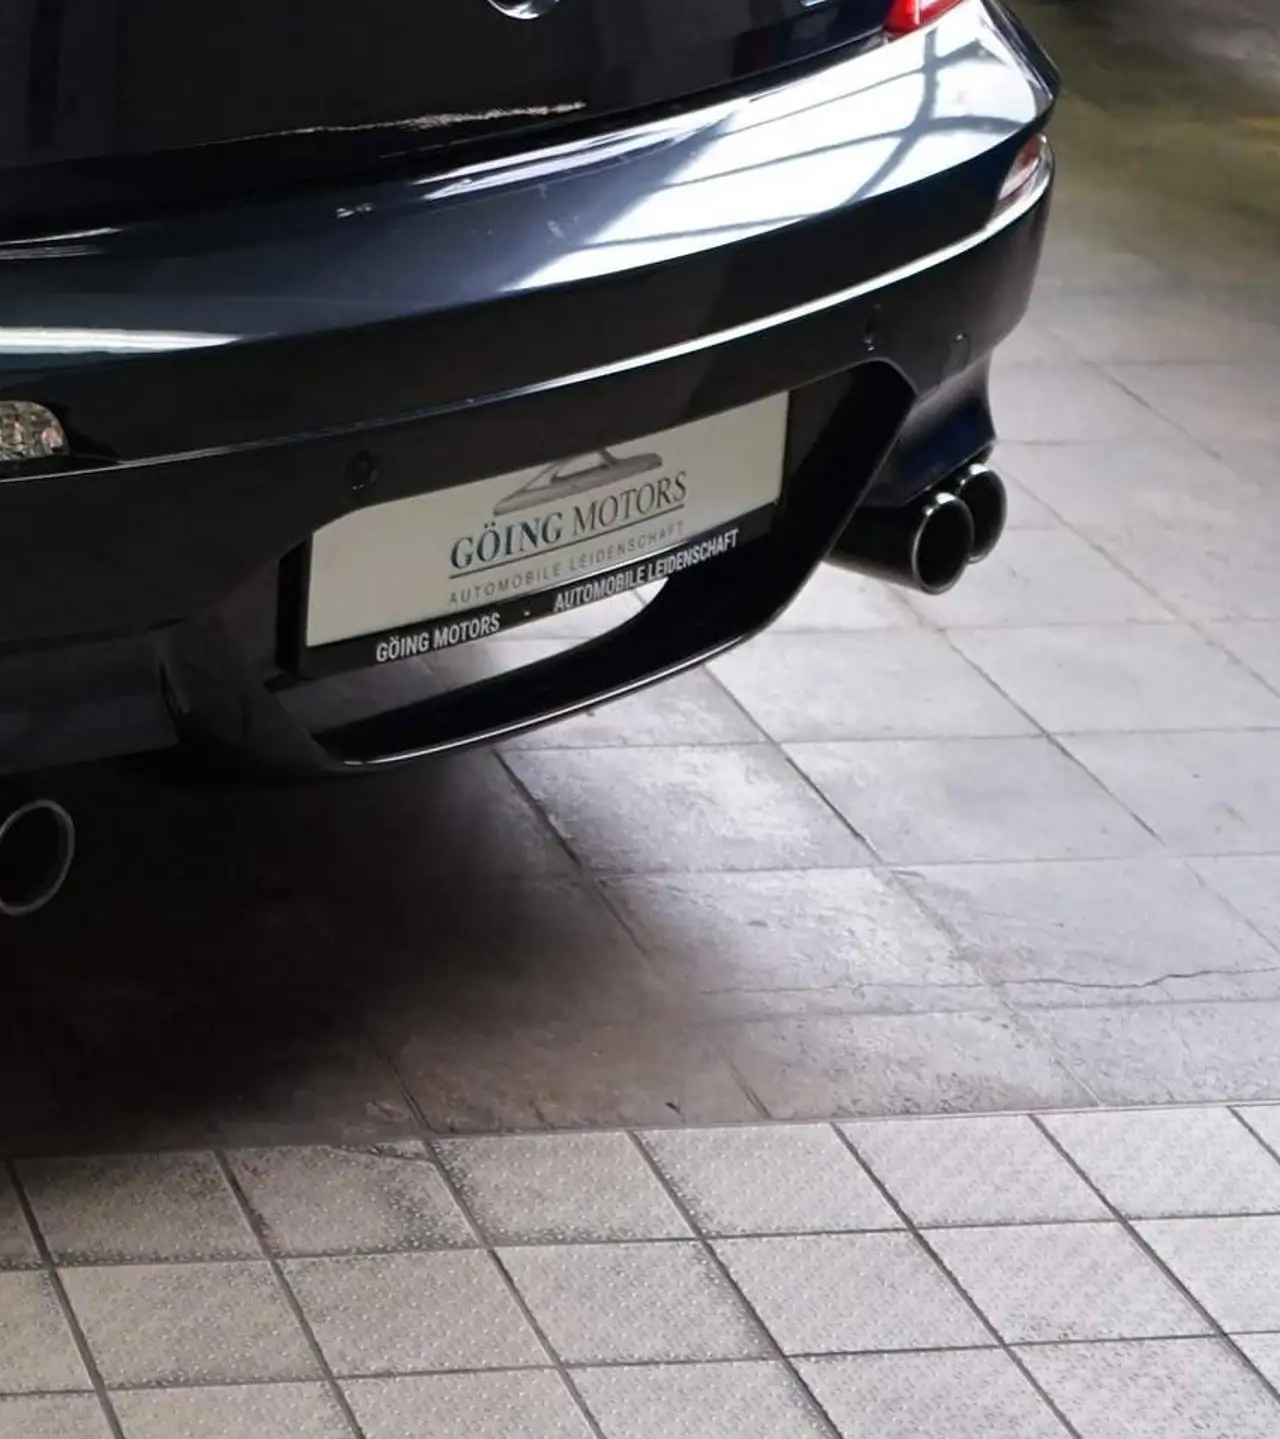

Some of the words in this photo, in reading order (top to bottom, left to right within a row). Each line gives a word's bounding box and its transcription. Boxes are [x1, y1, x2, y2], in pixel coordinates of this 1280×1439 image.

[448, 563, 562, 606] AUTOMOBILE
[569, 520, 686, 572] LEIDENSCHAFT
[450, 510, 564, 571] GÖING
[571, 470, 688, 536] MOTORS
[375, 630, 430, 663] GÖING
[433, 611, 501, 649] MOTORS
[553, 568, 646, 612] AUTOMOBILE
[646, 528, 740, 579] LEIDENSCHAFT
